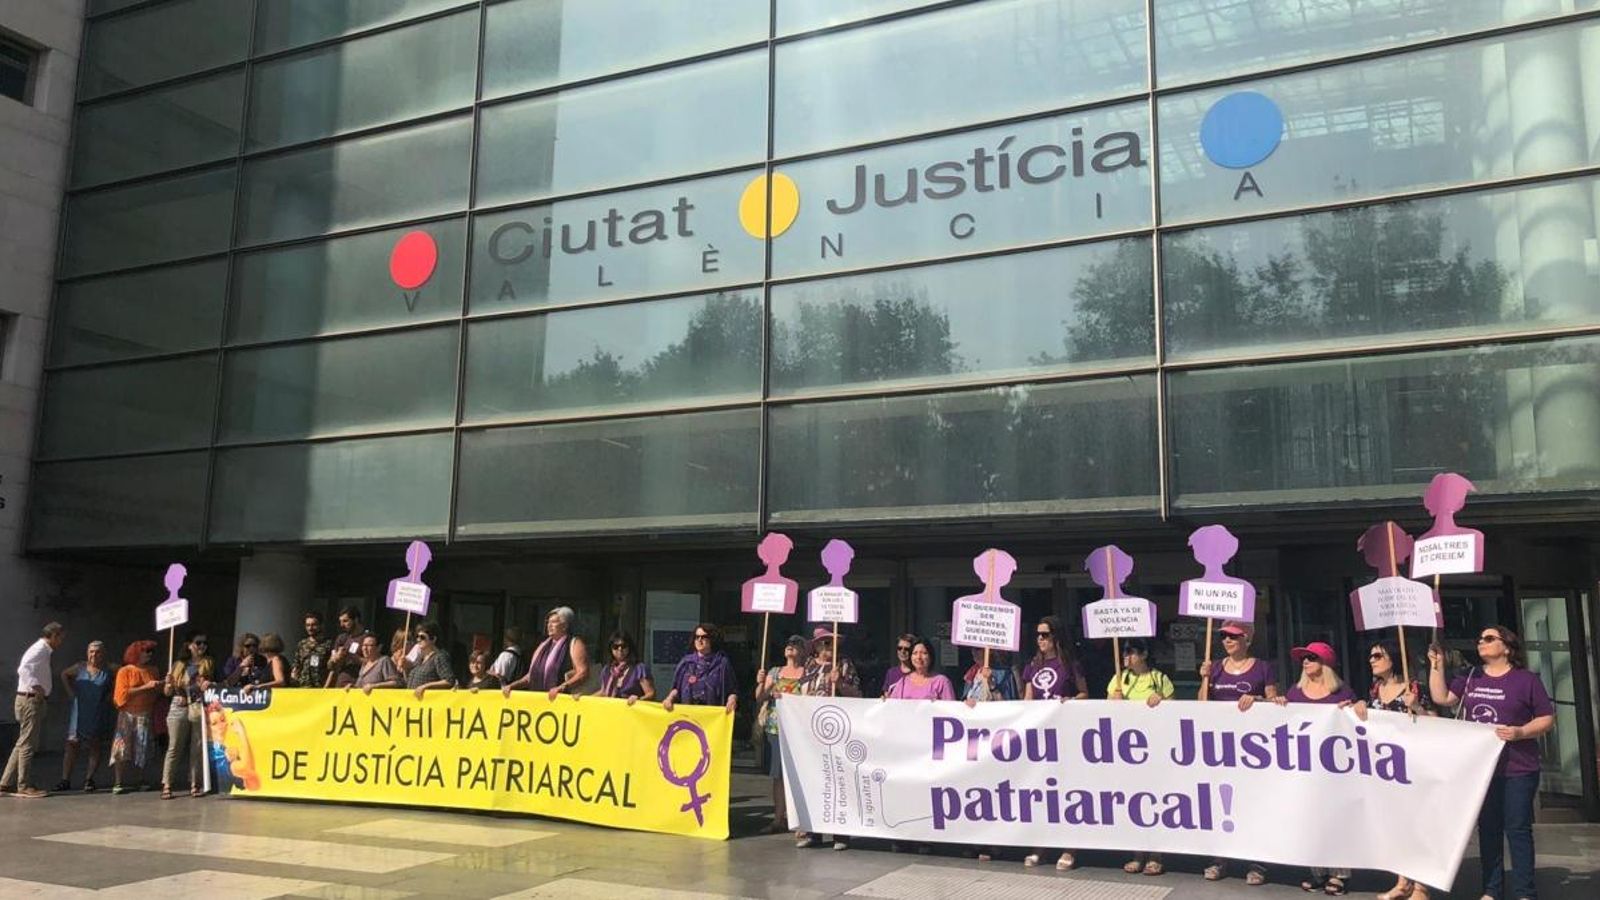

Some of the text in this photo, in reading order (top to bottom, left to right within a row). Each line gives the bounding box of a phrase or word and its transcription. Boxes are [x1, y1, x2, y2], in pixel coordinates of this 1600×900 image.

[488, 126, 1147, 266] Ciutat Justícia
[1418, 540, 1469, 553] NOSALTRES
[1420, 551, 1465, 564] ET CREIEM
[1194, 588, 1238, 599] NI UN PAS
[973, 603, 1015, 614] QUEREMOS
[1093, 607, 1119, 615] BASTA
[980, 612, 995, 620] SER
[1098, 616, 1140, 625] VIOLENCIA
[965, 626, 1007, 638] QUEREMOS
[1104, 624, 1137, 633] JUDICIAL
[963, 633, 978, 641] SER
[204, 688, 267, 704] We Can Do It!
[325, 705, 581, 748] JA N'HI HA PROU
[931, 716, 1412, 785] Prou de Justícia
[271, 744, 637, 809] DE JUSTÍCIA PATRIARCAL
[822, 753, 831, 823] coordinadora
[835, 756, 847, 825] de dones per
[930, 778, 1236, 833] patriarcal!
[864, 817, 875, 827] la
